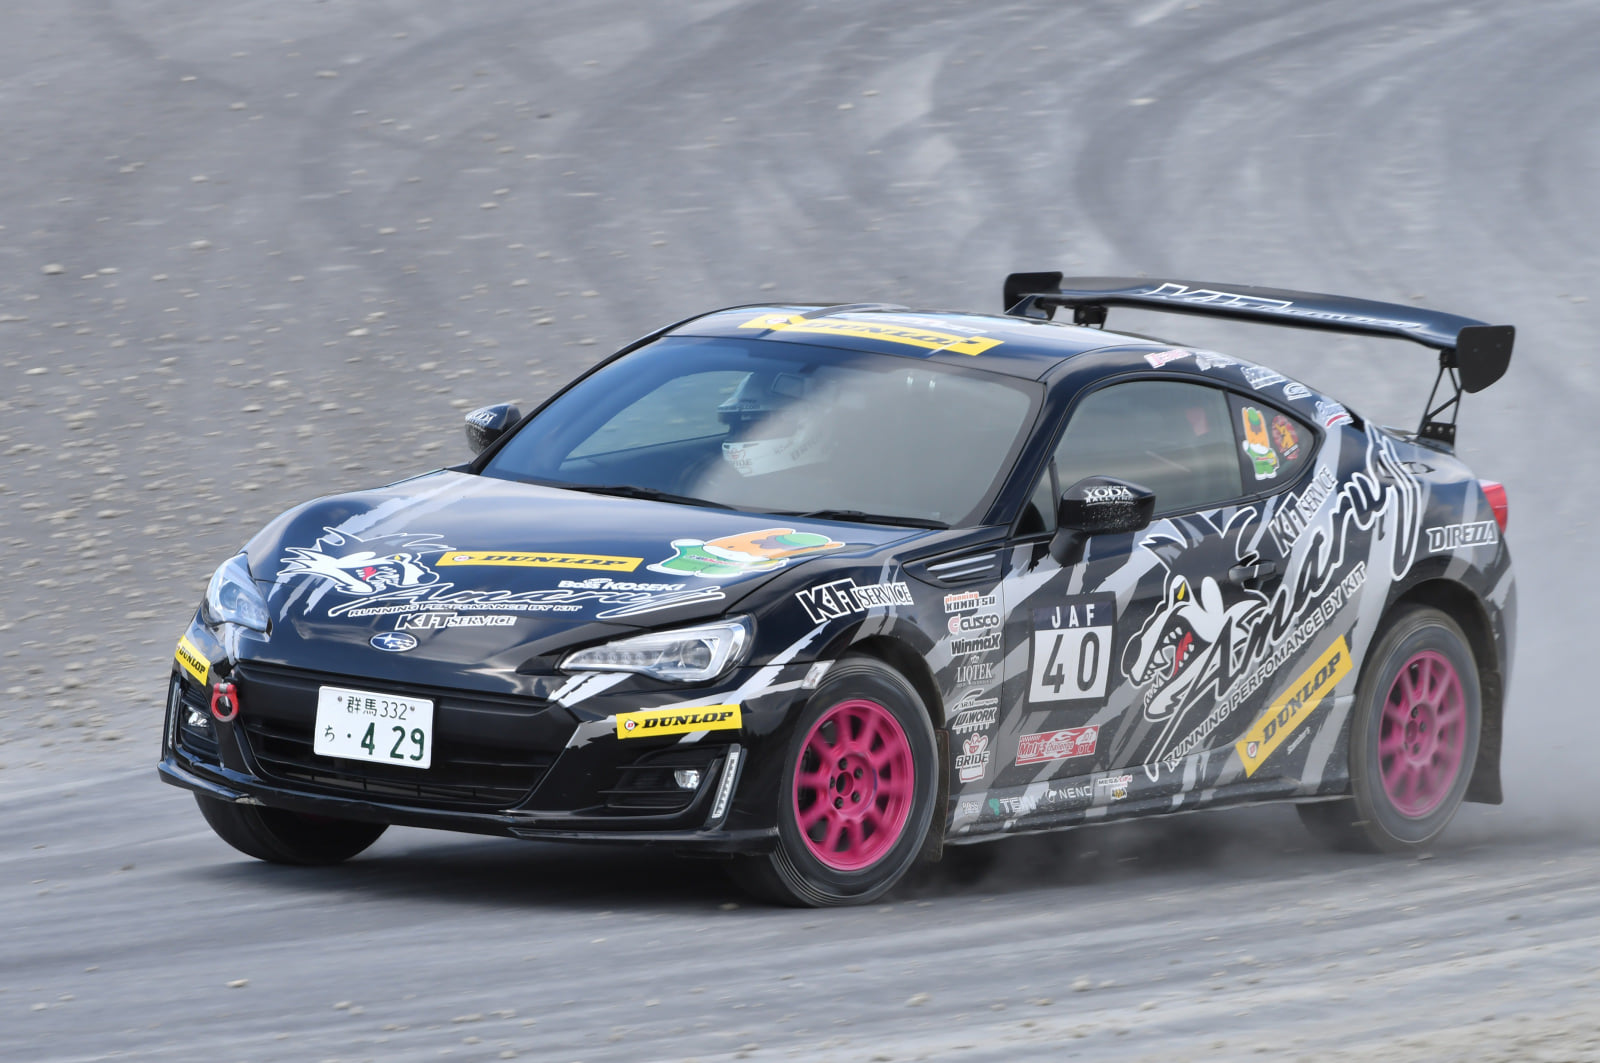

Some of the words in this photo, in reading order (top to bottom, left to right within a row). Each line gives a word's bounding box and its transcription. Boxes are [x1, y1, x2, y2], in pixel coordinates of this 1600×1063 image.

[1298, 464, 1338, 521] SERVICE
[1426, 520, 1499, 552] DIREZZA
[479, 555, 628, 566] DUNLOP
[856, 582, 913, 611] SERVICE
[447, 615, 518, 628] SERVICE
[179, 646, 206, 674] DUNLOP
[1042, 631, 1100, 694] 40
[1164, 704, 1231, 773] RUNNING
[1230, 613, 1324, 713] PERFOMANCE
[1320, 587, 1344, 623] BY
[1342, 560, 1369, 600] KIT
[1263, 652, 1342, 745] DUNLOP
[642, 711, 734, 729] DUNLOP
[956, 752, 990, 767] BRIDE
